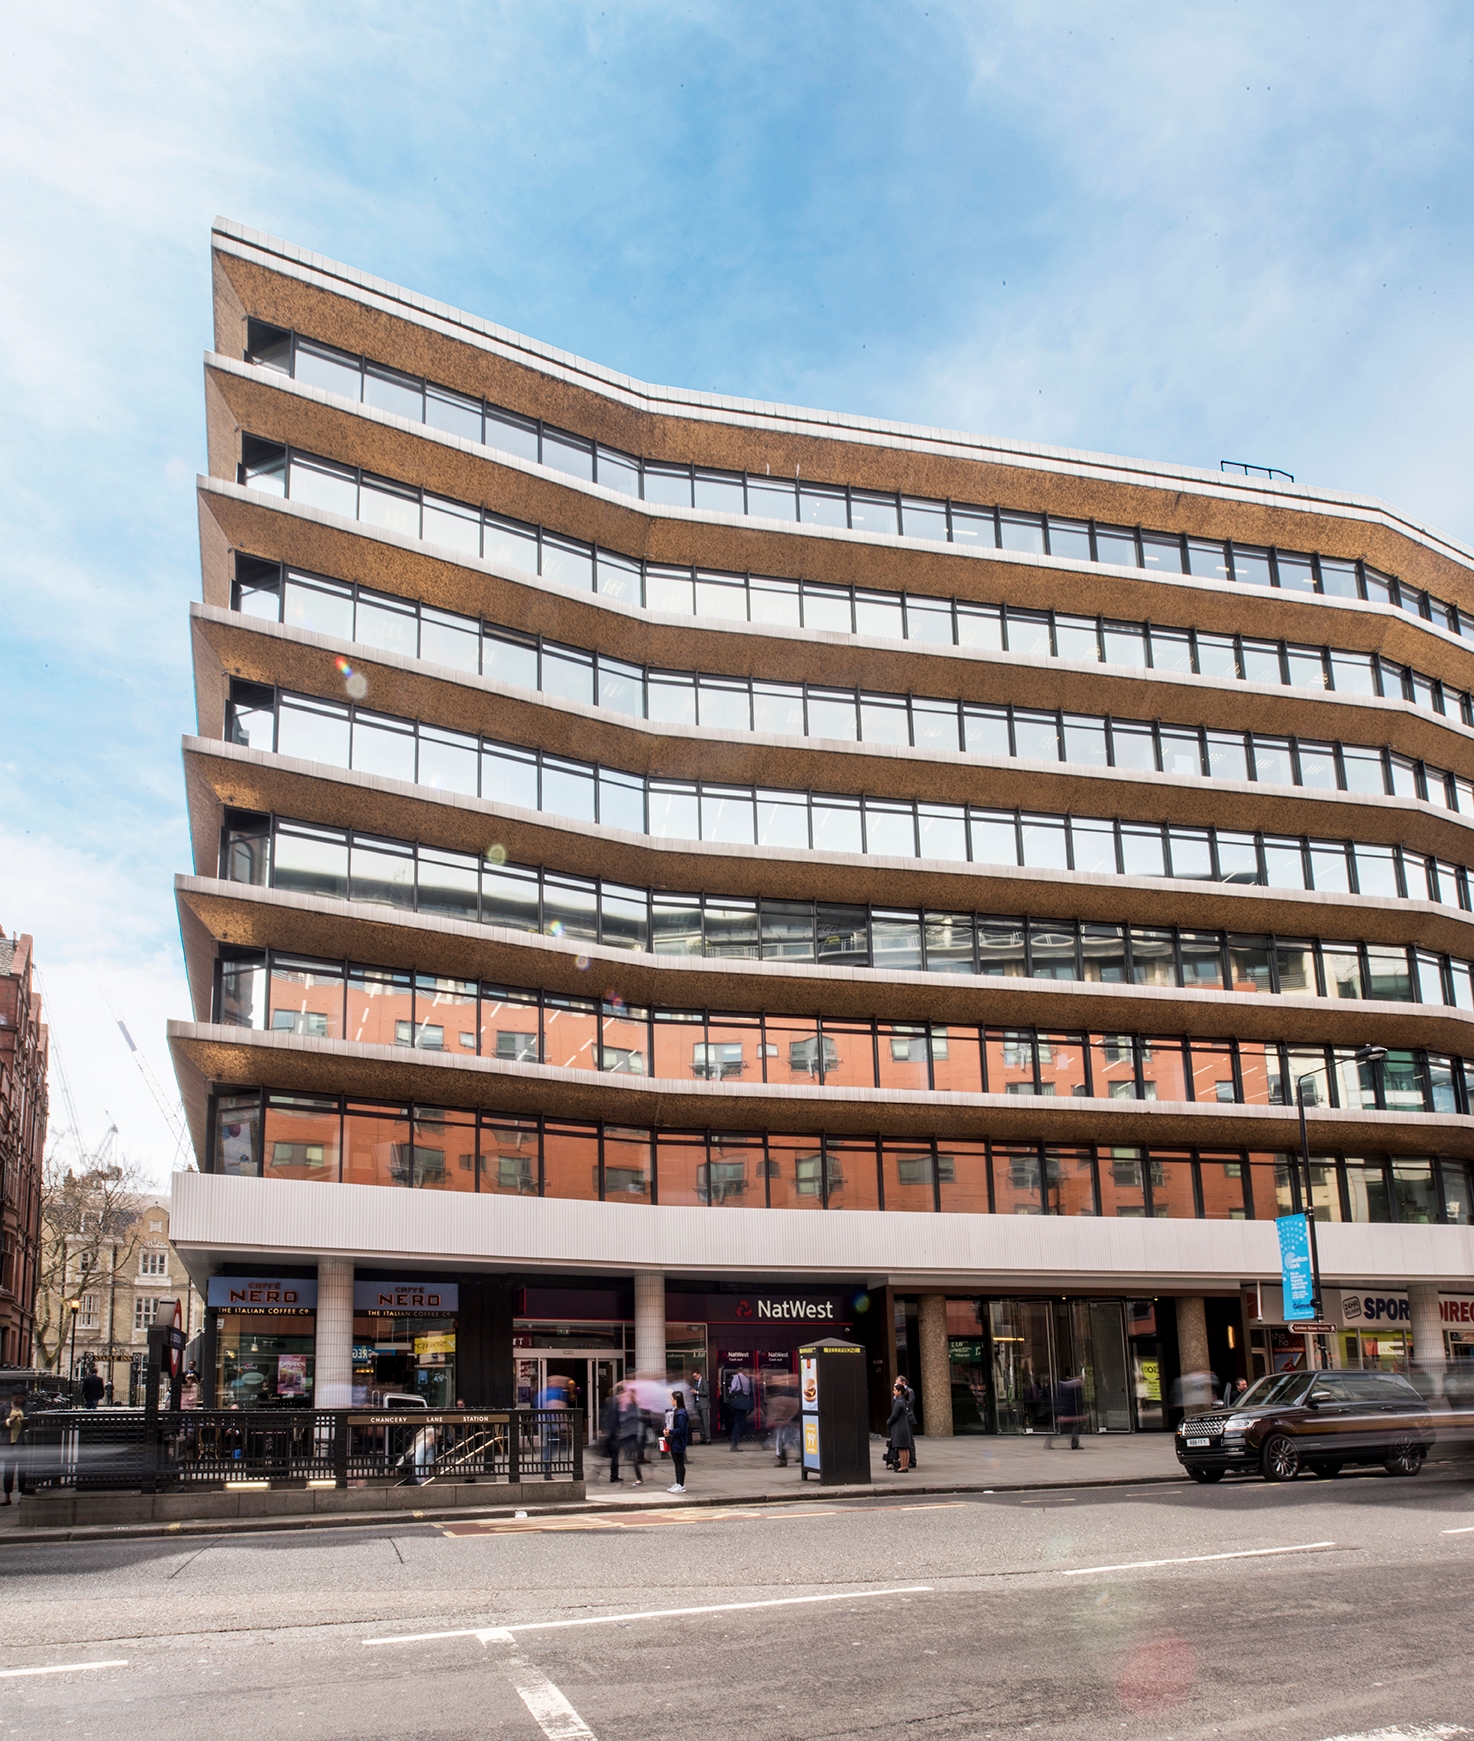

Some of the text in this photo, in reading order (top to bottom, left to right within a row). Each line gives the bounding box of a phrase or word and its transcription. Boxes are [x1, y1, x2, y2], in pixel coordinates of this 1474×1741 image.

[229, 1289, 298, 1303] NERO
[378, 1293, 441, 1307] NERO
[757, 1300, 834, 1319] NatWest
